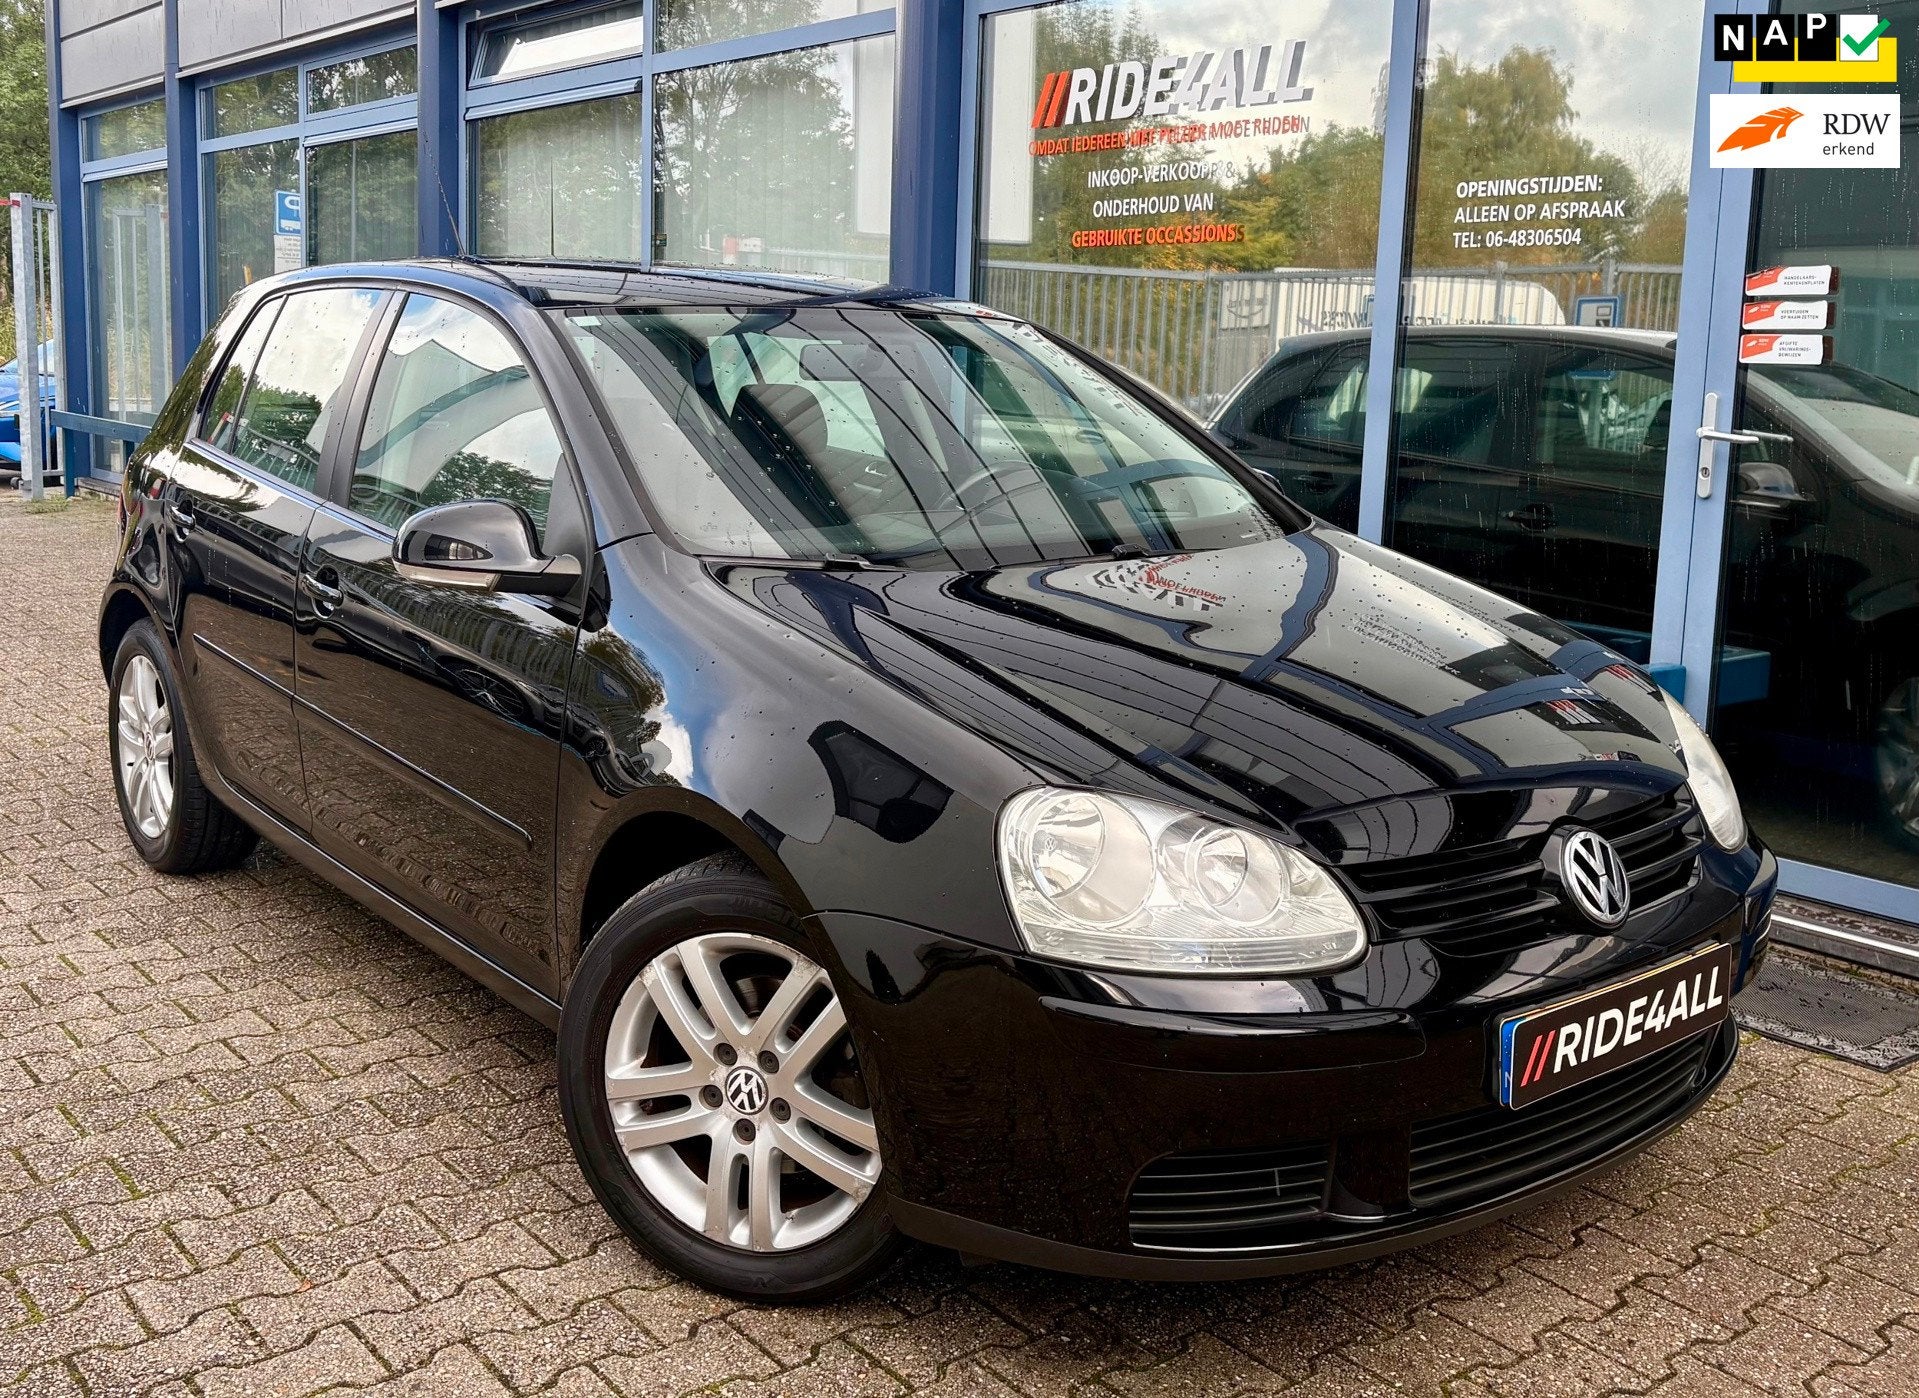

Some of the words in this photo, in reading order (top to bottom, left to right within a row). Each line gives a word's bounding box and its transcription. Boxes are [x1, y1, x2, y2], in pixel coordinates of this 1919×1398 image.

[1029, 137, 1069, 156] OMDAT
[1071, 132, 1127, 153] IEDEREEN
[1088, 161, 1212, 188] INKOOP-VERKOOP
[1456, 174, 1603, 198] OPENINGSTIJDEN:
[1092, 195, 1180, 218] ONDERHOUD
[1183, 192, 1214, 212] VAN
[1454, 204, 1510, 223] ALLEEN
[1514, 203, 1536, 221] OP
[1539, 200, 1626, 220] AFSPRAAK
[1072, 228, 1143, 248] GEBRUIKTE
[1146, 223, 1238, 244] OCCASSIONS
[1453, 231, 1482, 249] TEL:
[1485, 227, 1582, 247] 06-48306504
